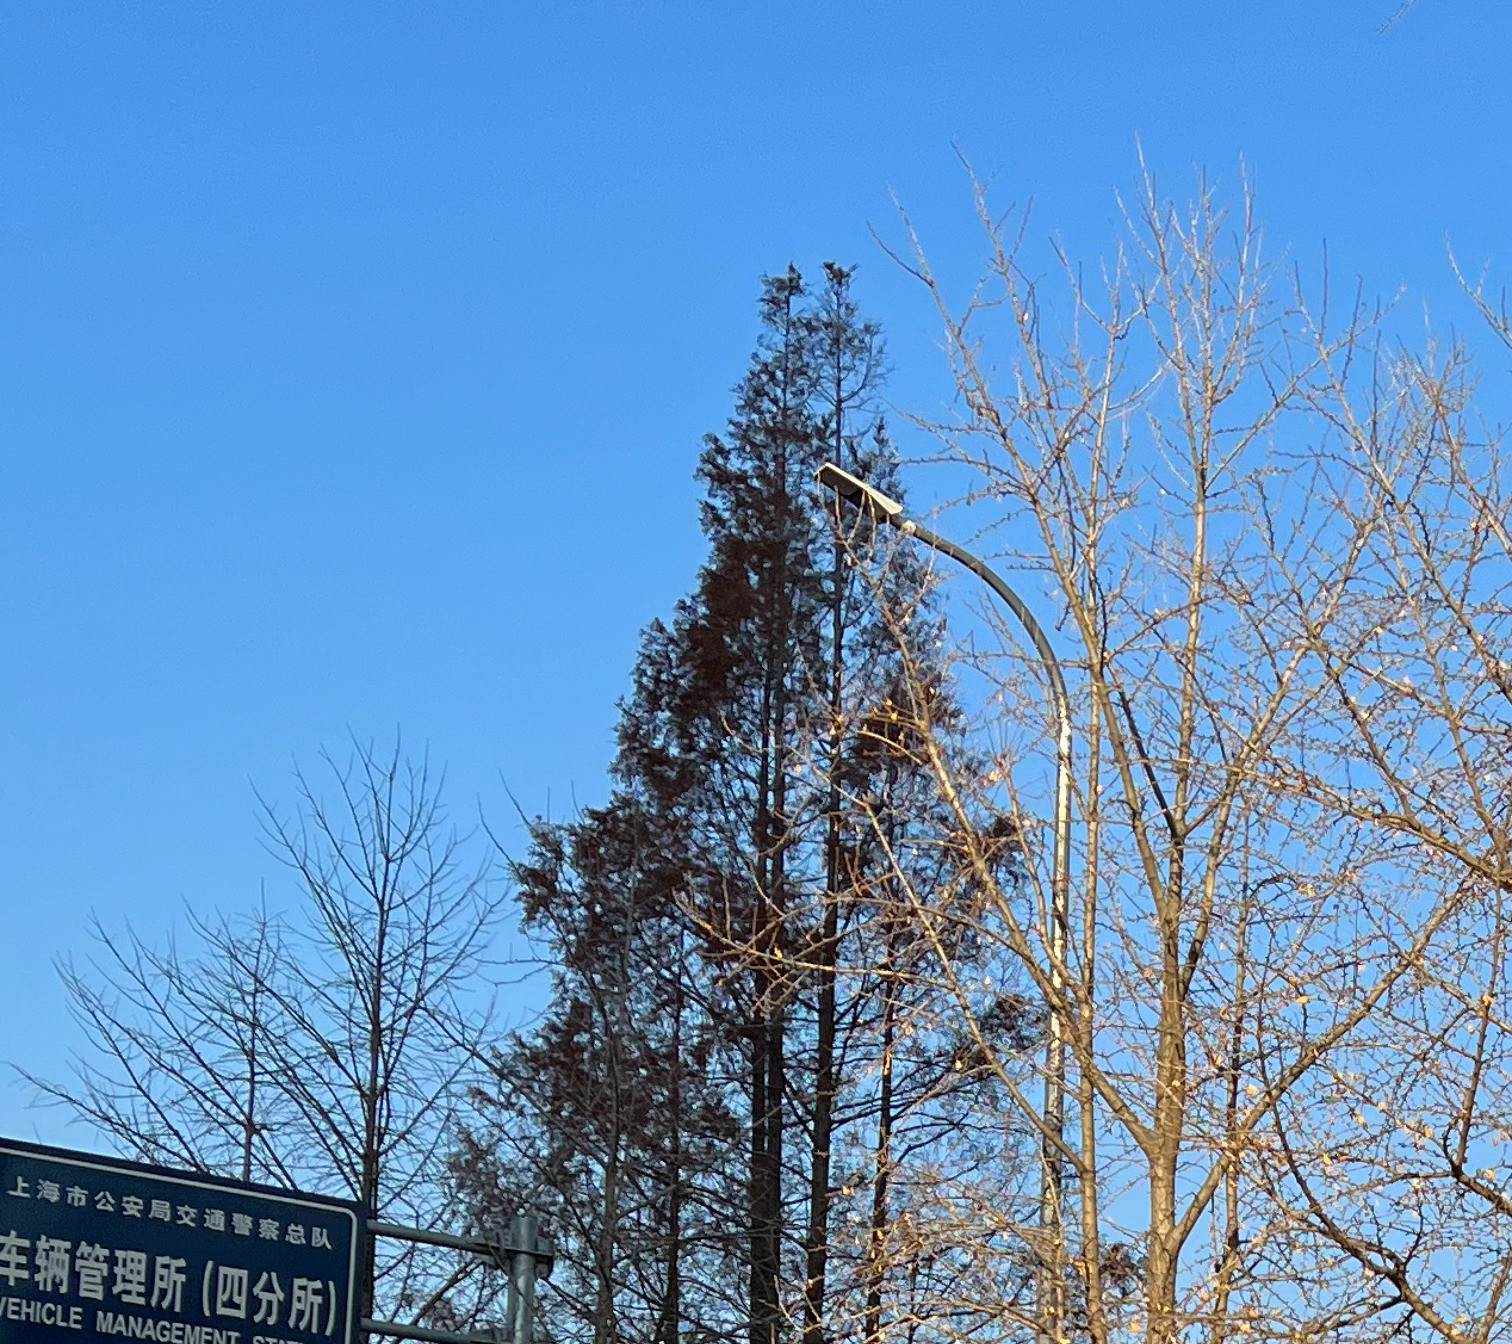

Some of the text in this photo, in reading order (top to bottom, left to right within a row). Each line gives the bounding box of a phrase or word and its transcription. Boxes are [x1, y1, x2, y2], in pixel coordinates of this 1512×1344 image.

[7, 1175, 332, 1250] 上海市公安局交通警察总队
